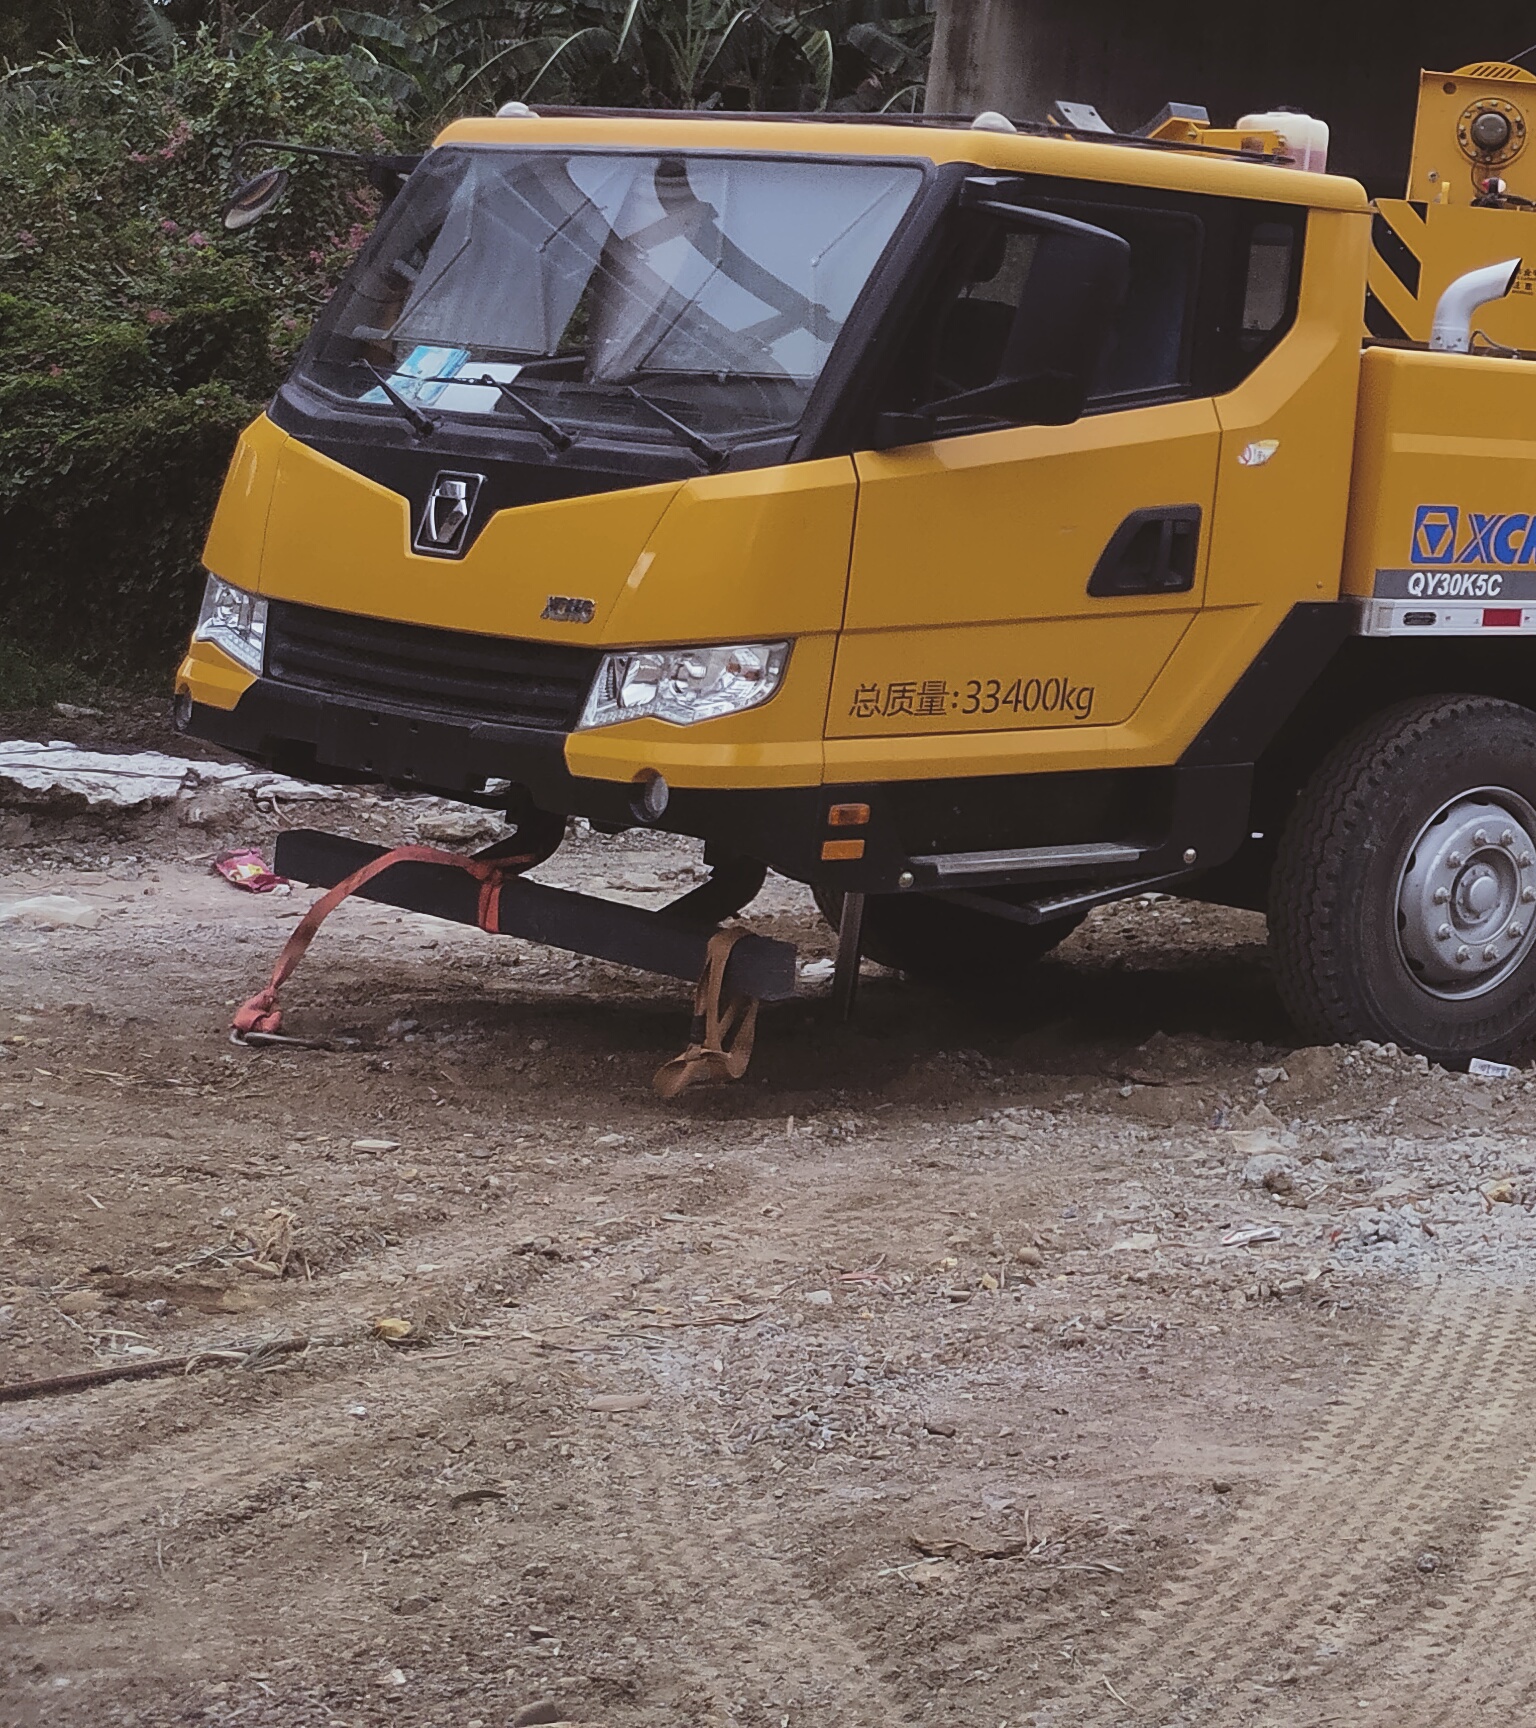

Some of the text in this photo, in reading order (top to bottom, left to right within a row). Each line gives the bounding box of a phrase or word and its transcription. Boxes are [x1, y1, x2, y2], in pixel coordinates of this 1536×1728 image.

[1407, 572, 1503, 597] QY30K5C
[848, 677, 1095, 720] 总质量:33400kg
